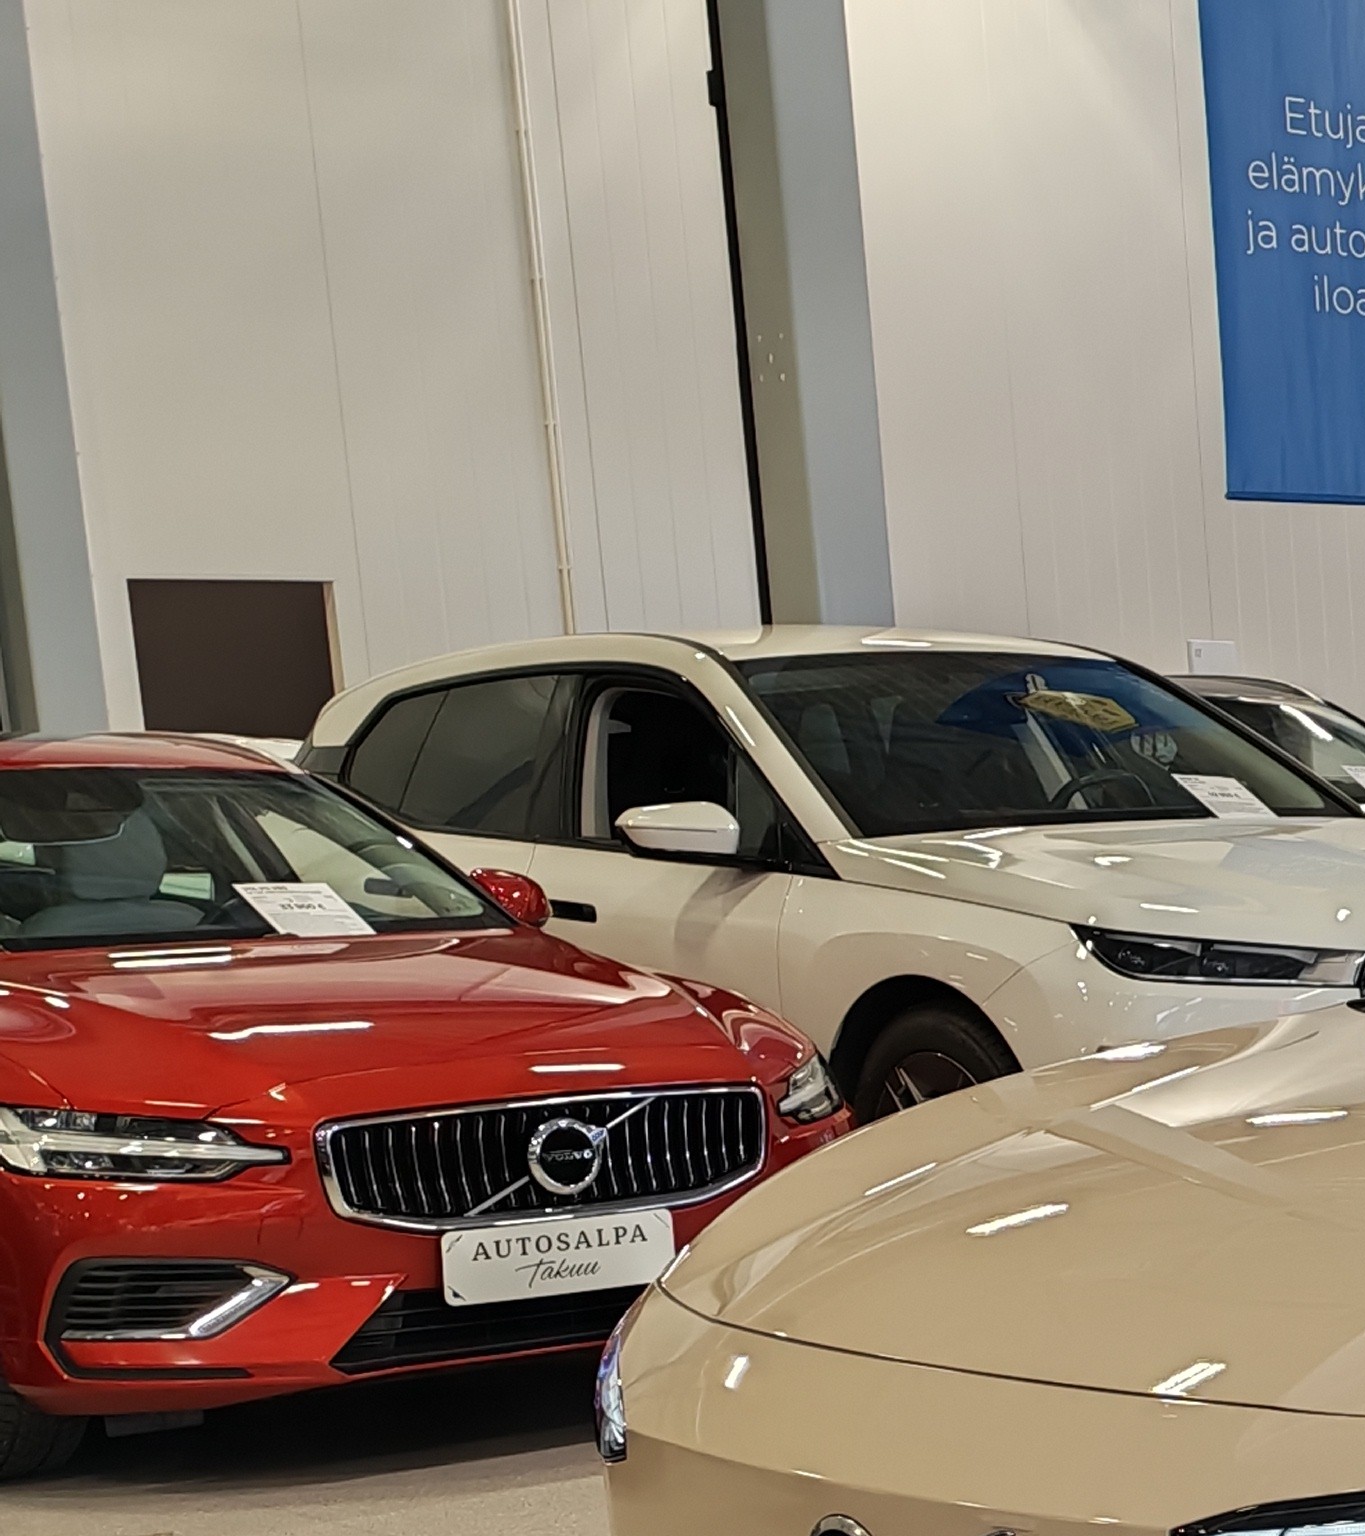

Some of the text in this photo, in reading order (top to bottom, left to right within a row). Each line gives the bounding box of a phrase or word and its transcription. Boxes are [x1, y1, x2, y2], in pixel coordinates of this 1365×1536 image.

[1246, 209, 1277, 255] ja
[472, 1223, 648, 1262] AUTOSALPA
[515, 1258, 601, 1289] Takuu
